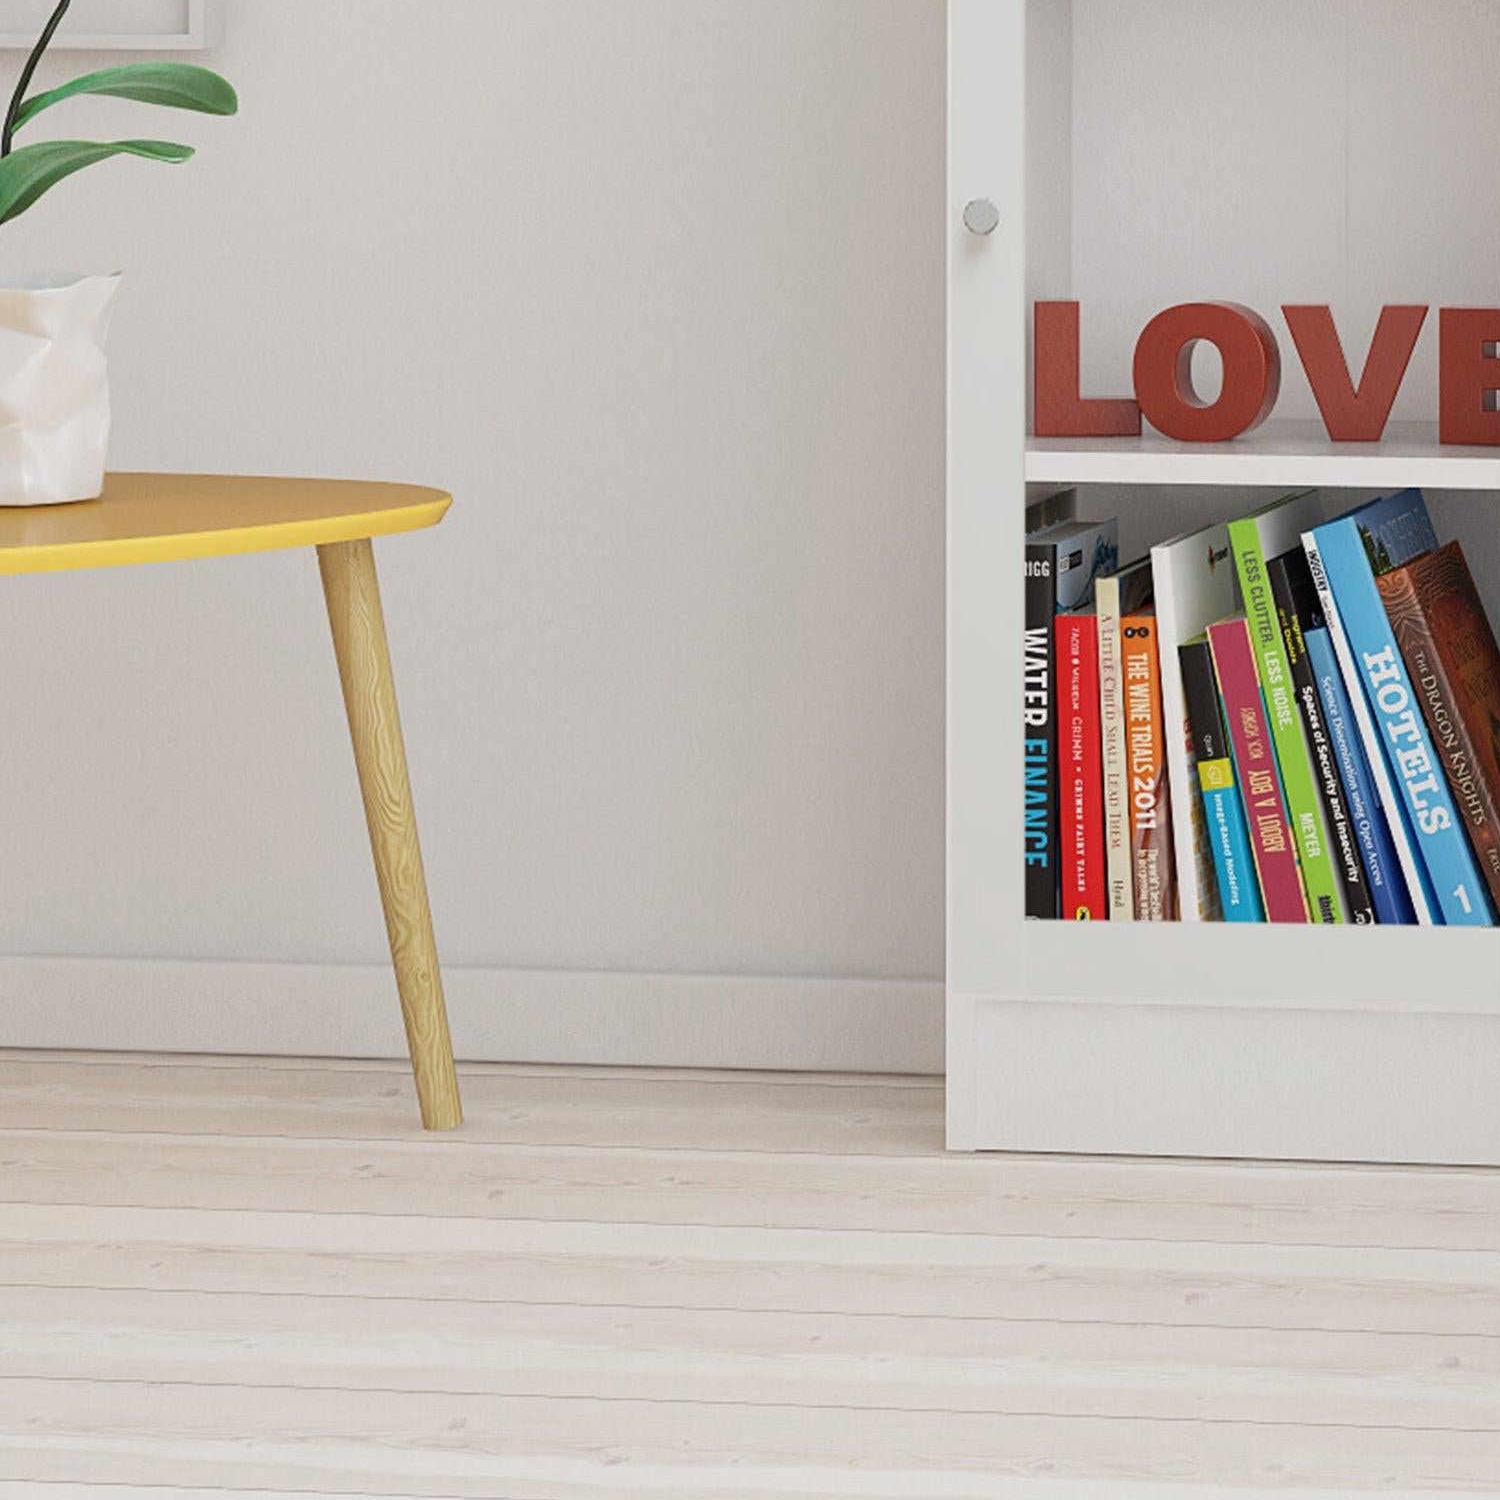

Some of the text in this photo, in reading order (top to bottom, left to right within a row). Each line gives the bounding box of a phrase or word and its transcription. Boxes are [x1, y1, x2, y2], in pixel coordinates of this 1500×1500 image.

[1242, 550, 1262, 583] LESS
[1250, 586, 1275, 648] CLUTTER.
[1102, 629, 1114, 671] LITTLE
[1263, 651, 1284, 685] LESS
[1103, 676, 1116, 721] CHILD
[1025, 627, 1048, 868] WATER FINANCE
[1071, 717, 1083, 762] GRIMM
[1105, 725, 1118, 769] SHALL
[1127, 653, 1157, 830] THE WINE TRIALS 2011
[1362, 644, 1452, 836] HOTELS
[1414, 650, 1488, 827] THE DRAGON KNIGHTS
[1106, 772, 1120, 808] LEAD
[1302, 685, 1361, 884] Spaces of Security and Insecurity
[1321, 675, 1383, 887] Science Dissemination using Open Access
[1109, 813, 1122, 850] THEM
[1247, 769, 1286, 853] ABOUT A BOY
[1076, 823, 1085, 856] FAIRY
[1300, 811, 1321, 859] MEYER
[1076, 858, 1086, 893] TALES
[1225, 858, 1240, 907] Modeling
[1453, 883, 1473, 915] 1
